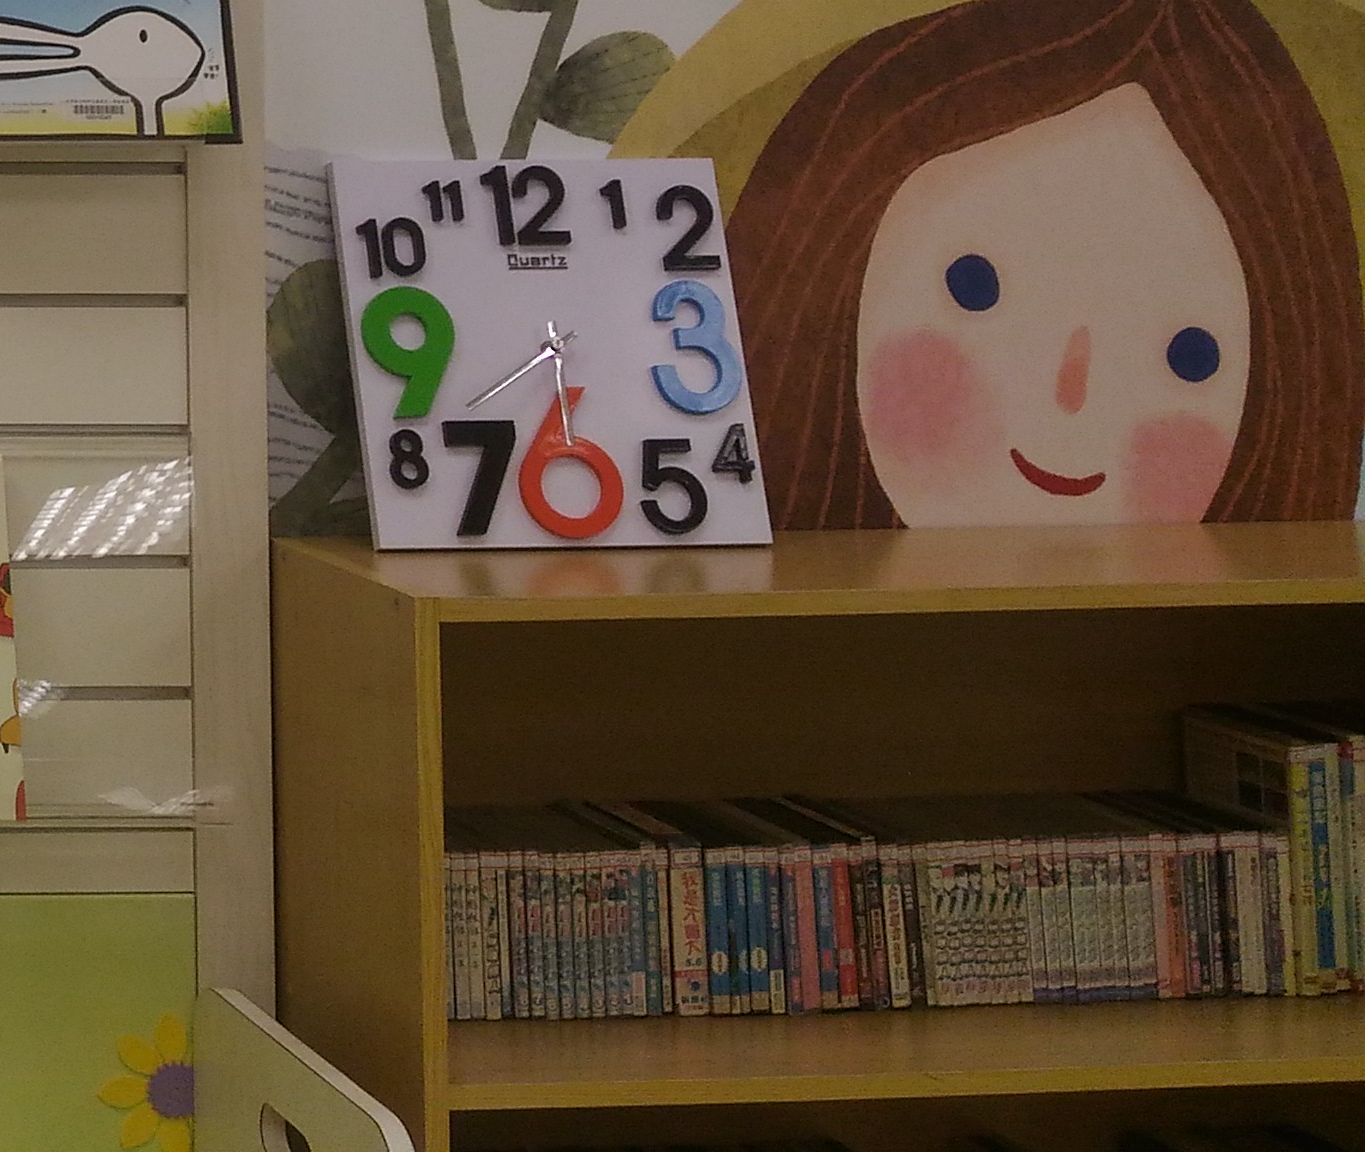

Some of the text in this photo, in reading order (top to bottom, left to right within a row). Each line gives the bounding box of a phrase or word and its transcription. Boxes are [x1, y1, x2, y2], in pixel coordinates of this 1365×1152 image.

[421, 179, 466, 223] 11
[480, 165, 572, 246] 12
[599, 179, 628, 230] 1
[655, 184, 722, 272] 2
[355, 216, 427, 279] 10
[507, 253, 569, 268] Quartz
[360, 285, 456, 420] 9
[650, 279, 742, 415] 3
[388, 428, 430, 490] 8
[441, 419, 517, 538] 7
[518, 385, 625, 540] 6
[639, 438, 709, 536] 5
[711, 422, 756, 485] 4
